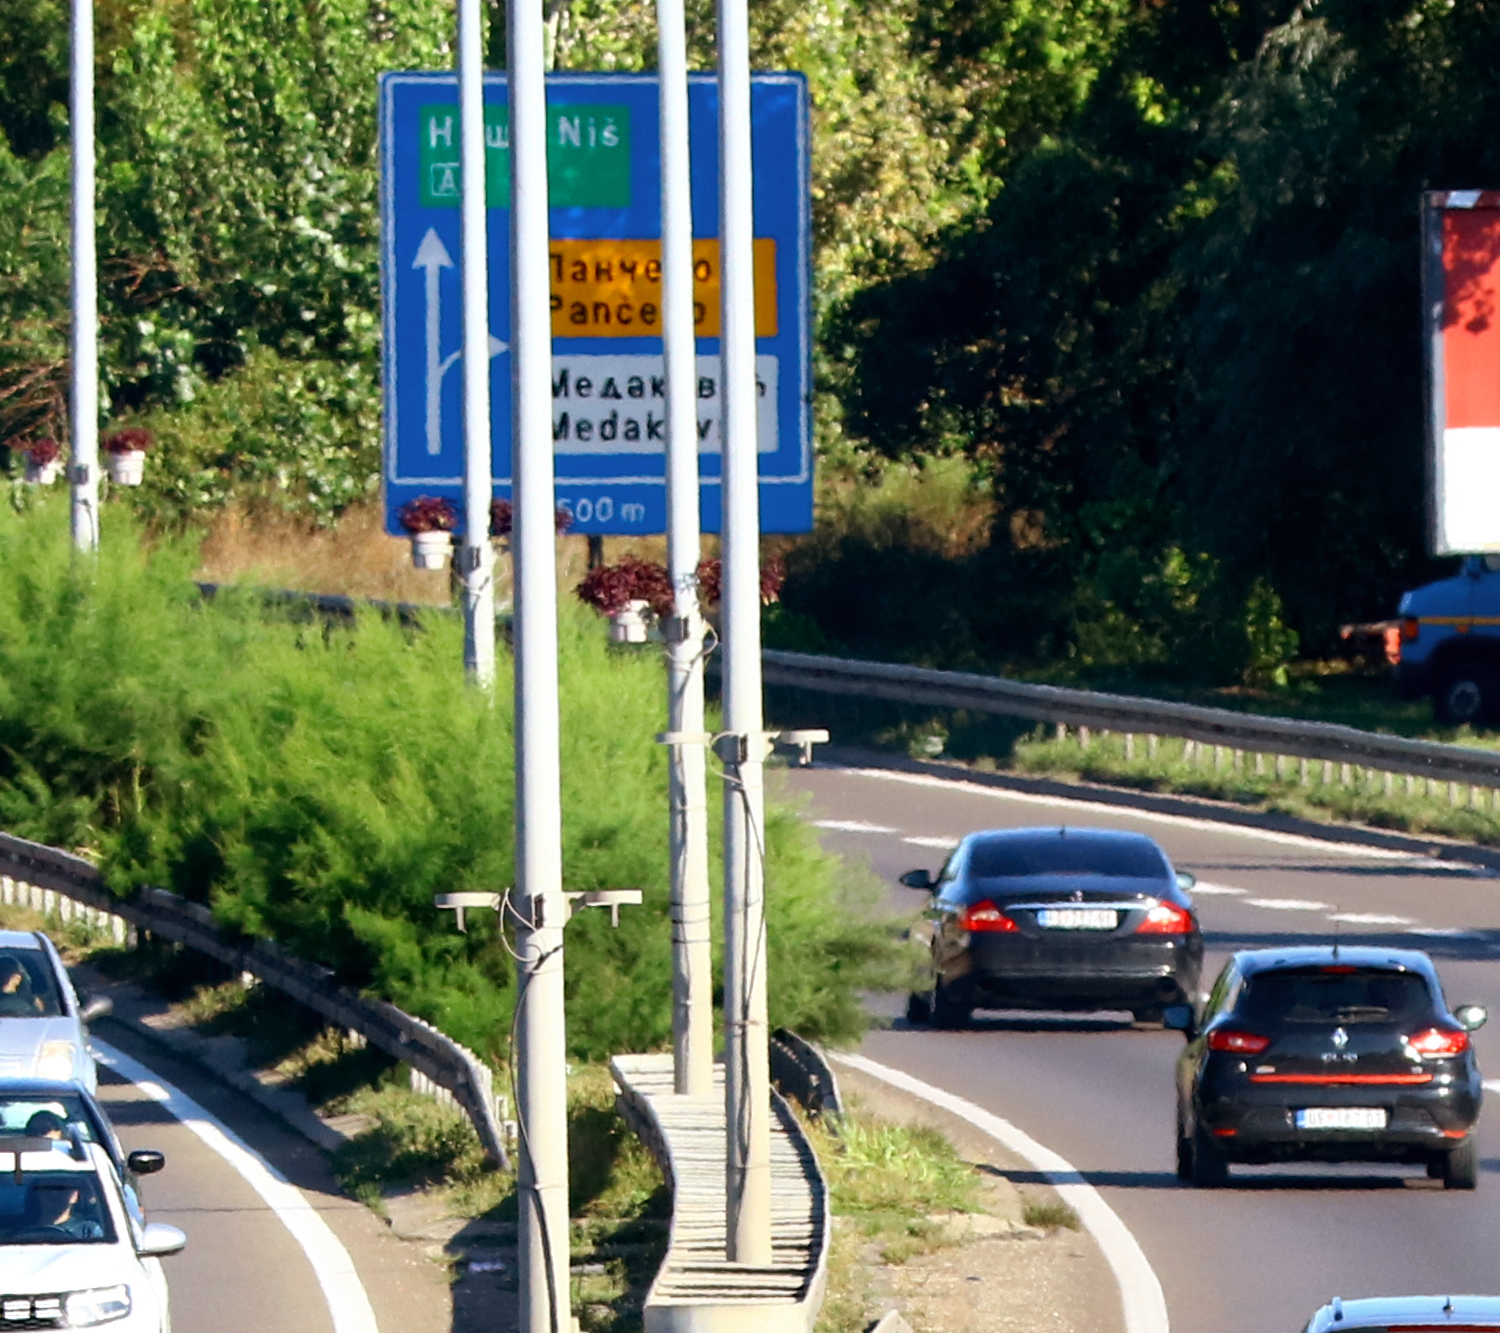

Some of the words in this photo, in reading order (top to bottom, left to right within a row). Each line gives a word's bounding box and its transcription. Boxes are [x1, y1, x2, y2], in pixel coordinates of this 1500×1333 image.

[428, 115, 510, 149] Нш
[558, 115, 620, 147] Niš
[550, 253, 711, 283] Панчео
[550, 293, 707, 325] Pančeo
[621, 502, 645, 522] m
